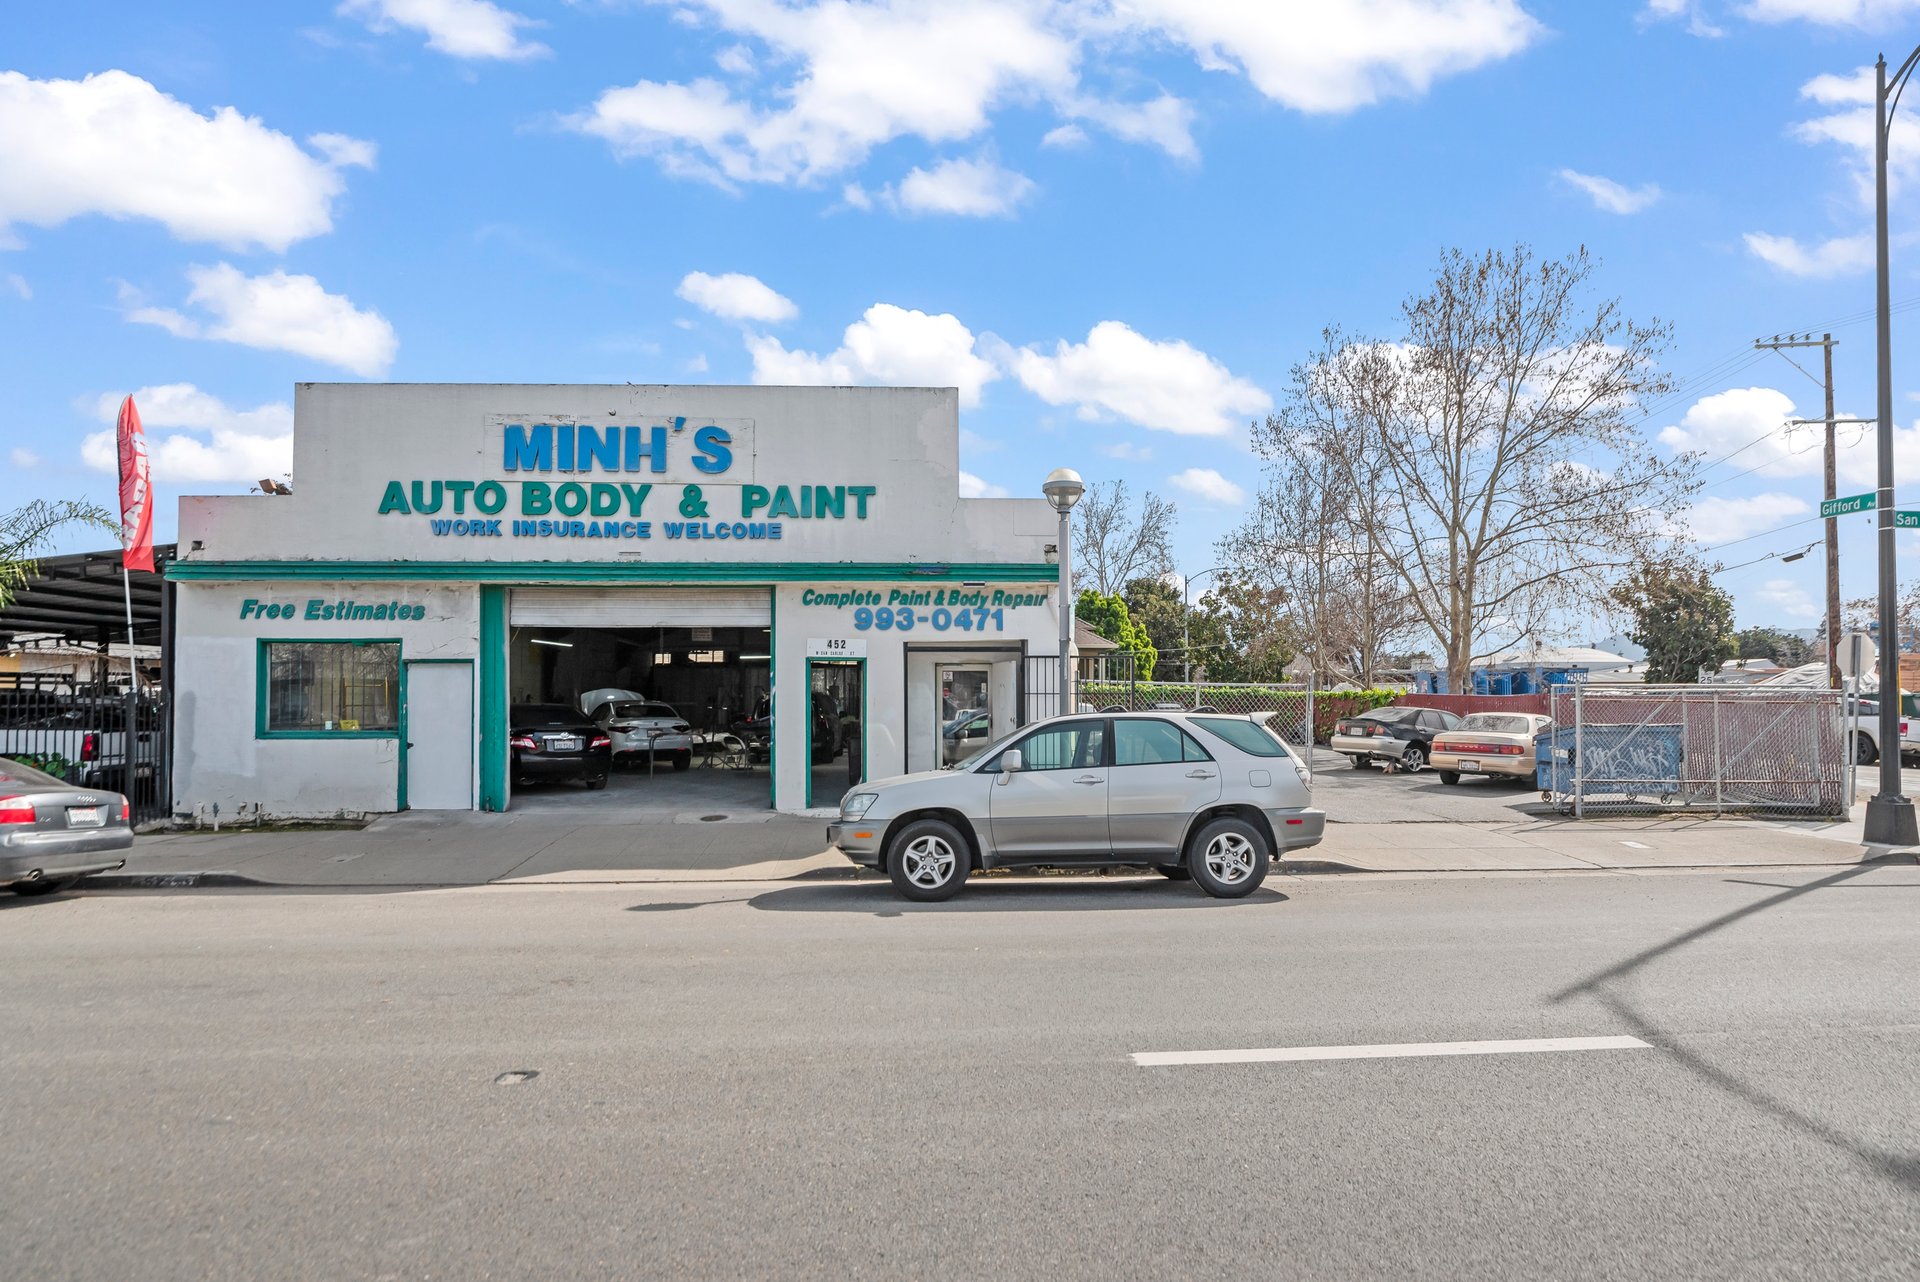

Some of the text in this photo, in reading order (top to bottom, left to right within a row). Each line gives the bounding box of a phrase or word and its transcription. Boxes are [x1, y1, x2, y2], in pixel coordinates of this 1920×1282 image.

[503, 417, 733, 474] MINH'S
[378, 480, 877, 519] AUTO BODY & PAINT
[1822, 498, 1861, 515] Gifford
[430, 519, 783, 540] WORK INSURANCE WELCOME
[1896, 513, 1918, 526] San
[801, 588, 1049, 609] Complete Paint & Body Repair
[239, 599, 426, 621] Free Estimates
[853, 607, 1004, 632] 993-0471
[827, 639, 846, 649] 452
[1700, 676, 1713, 684] 25
